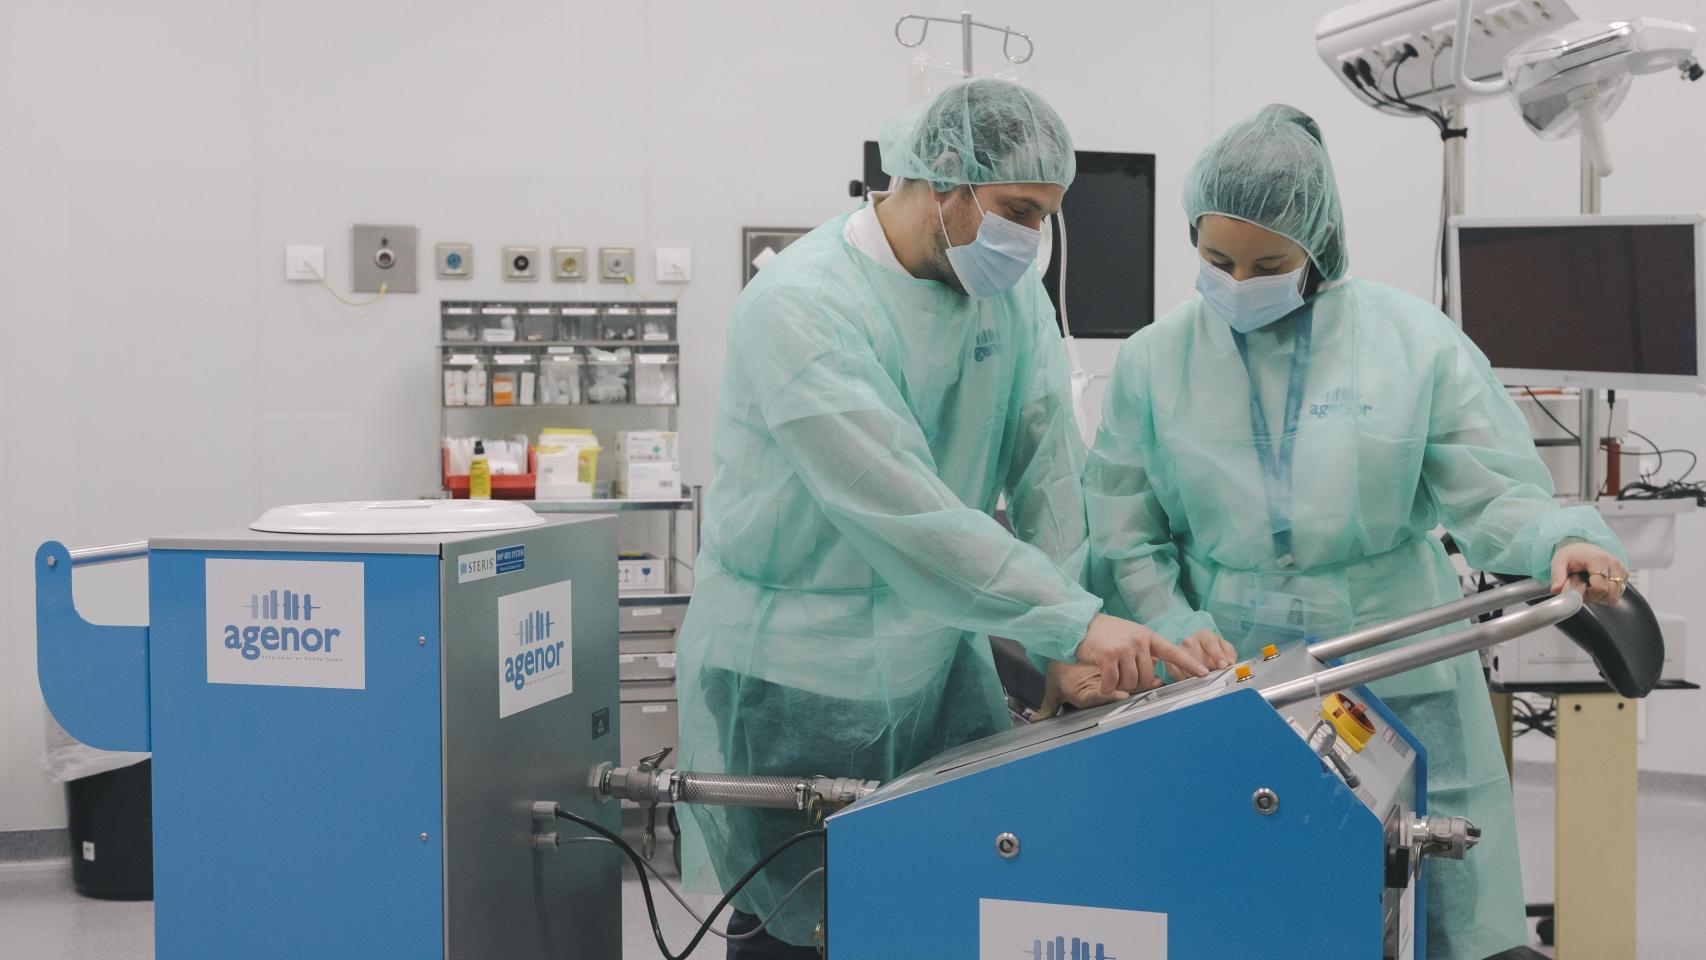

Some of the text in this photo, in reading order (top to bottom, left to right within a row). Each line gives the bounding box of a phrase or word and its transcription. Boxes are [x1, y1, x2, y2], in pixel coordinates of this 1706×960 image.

[468, 557, 494, 574] STERIS
[224, 624, 341, 661] agenor
[504, 640, 565, 690] agenor
